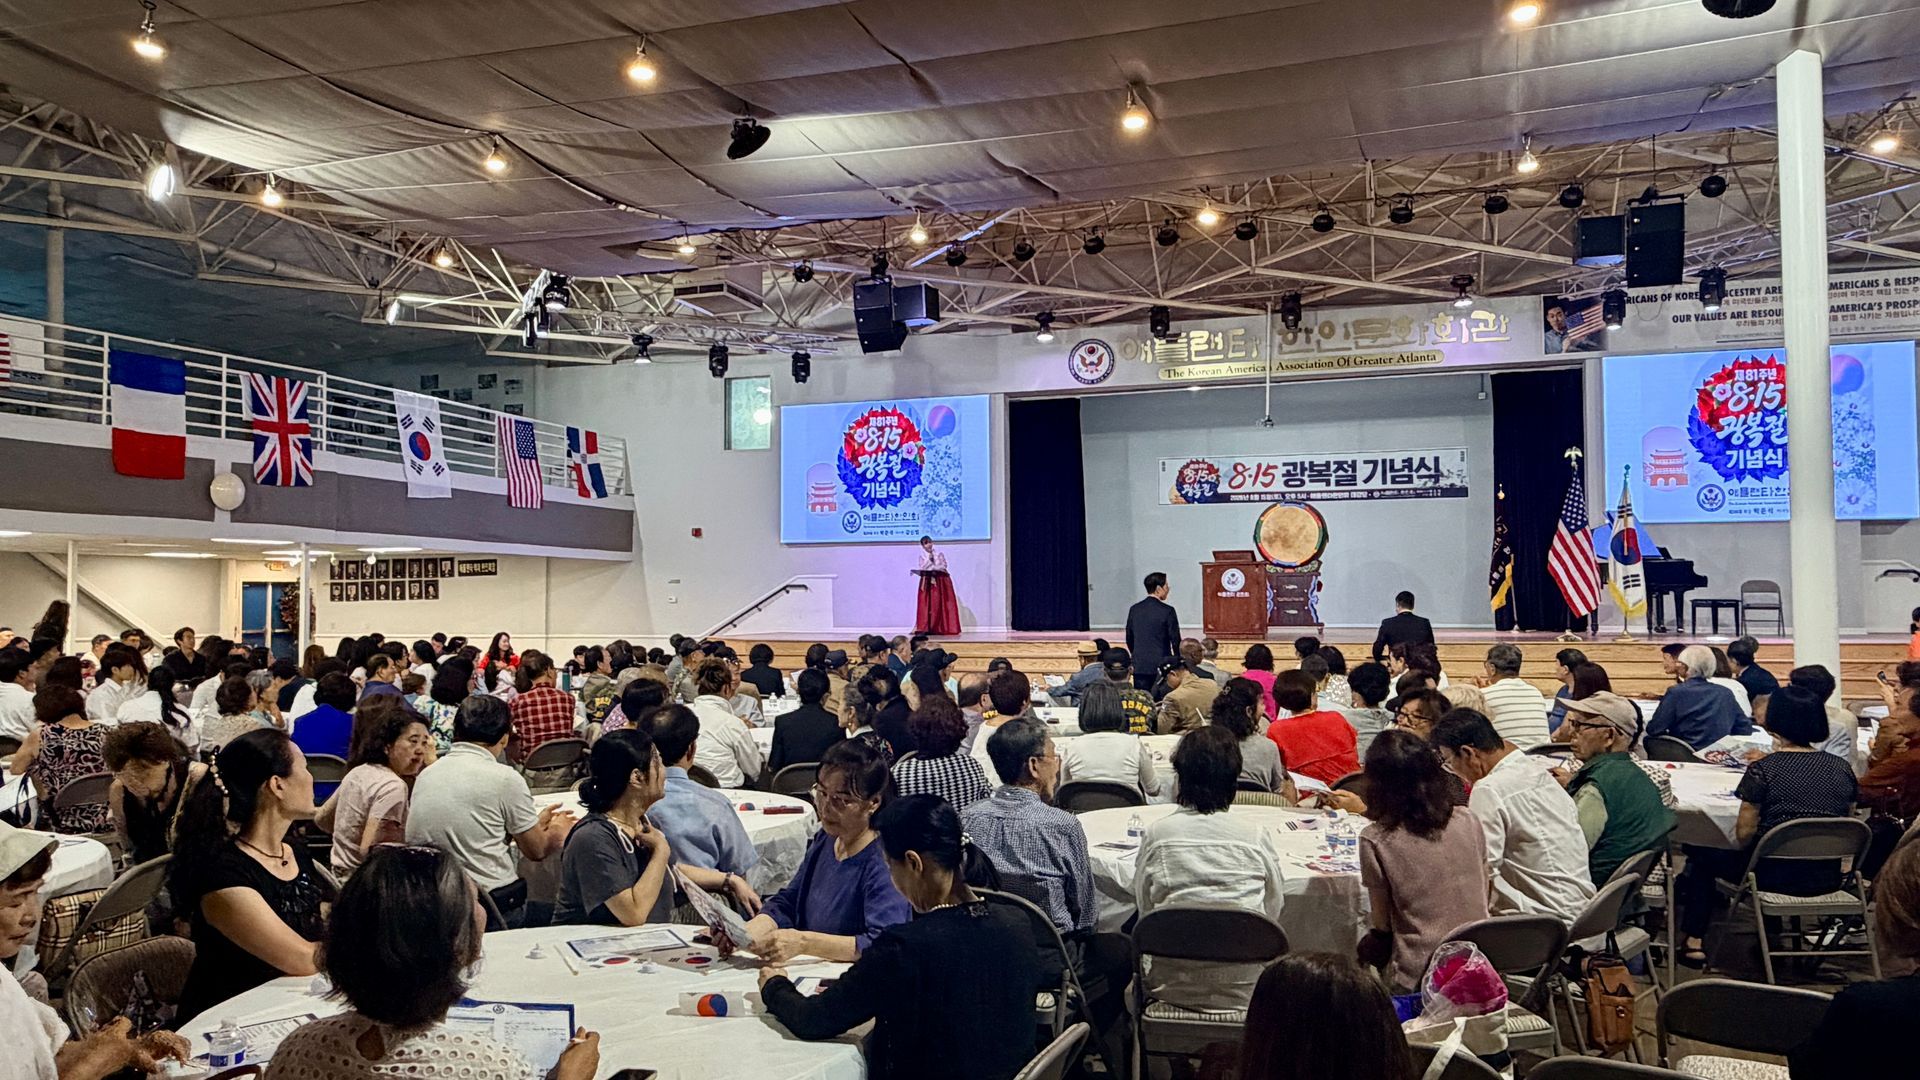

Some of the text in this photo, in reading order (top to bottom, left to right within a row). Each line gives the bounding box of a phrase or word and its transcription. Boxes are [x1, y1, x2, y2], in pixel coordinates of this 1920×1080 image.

[1626, 276, 1920, 304] RICANS OF KORE CESTRY ARE MERICANS & RESP
[1672, 314, 1692, 324] OUR
[1694, 311, 1727, 322] VALUES
[1730, 310, 1748, 319] ARE
[1830, 302, 1883, 313] AMERICA'S
[1886, 299, 1920, 309] PROSP
[1165, 368, 1185, 379] The
[1188, 367, 1222, 377] Korean
[1277, 359, 1334, 371] Association
[1337, 356, 1351, 367] Of
[1354, 354, 1394, 366] Greater
[1397, 352, 1437, 363] Atlanta
[1734, 367, 1777, 381] 제81주년
[1716, 411, 1788, 449] 광복절
[856, 450, 908, 480] 광복절
[1281, 460, 1358, 487] 광복절
[1362, 456, 1440, 485] 기념식
[1726, 448, 1784, 469] 기념식
[862, 481, 902, 499] 기념식
